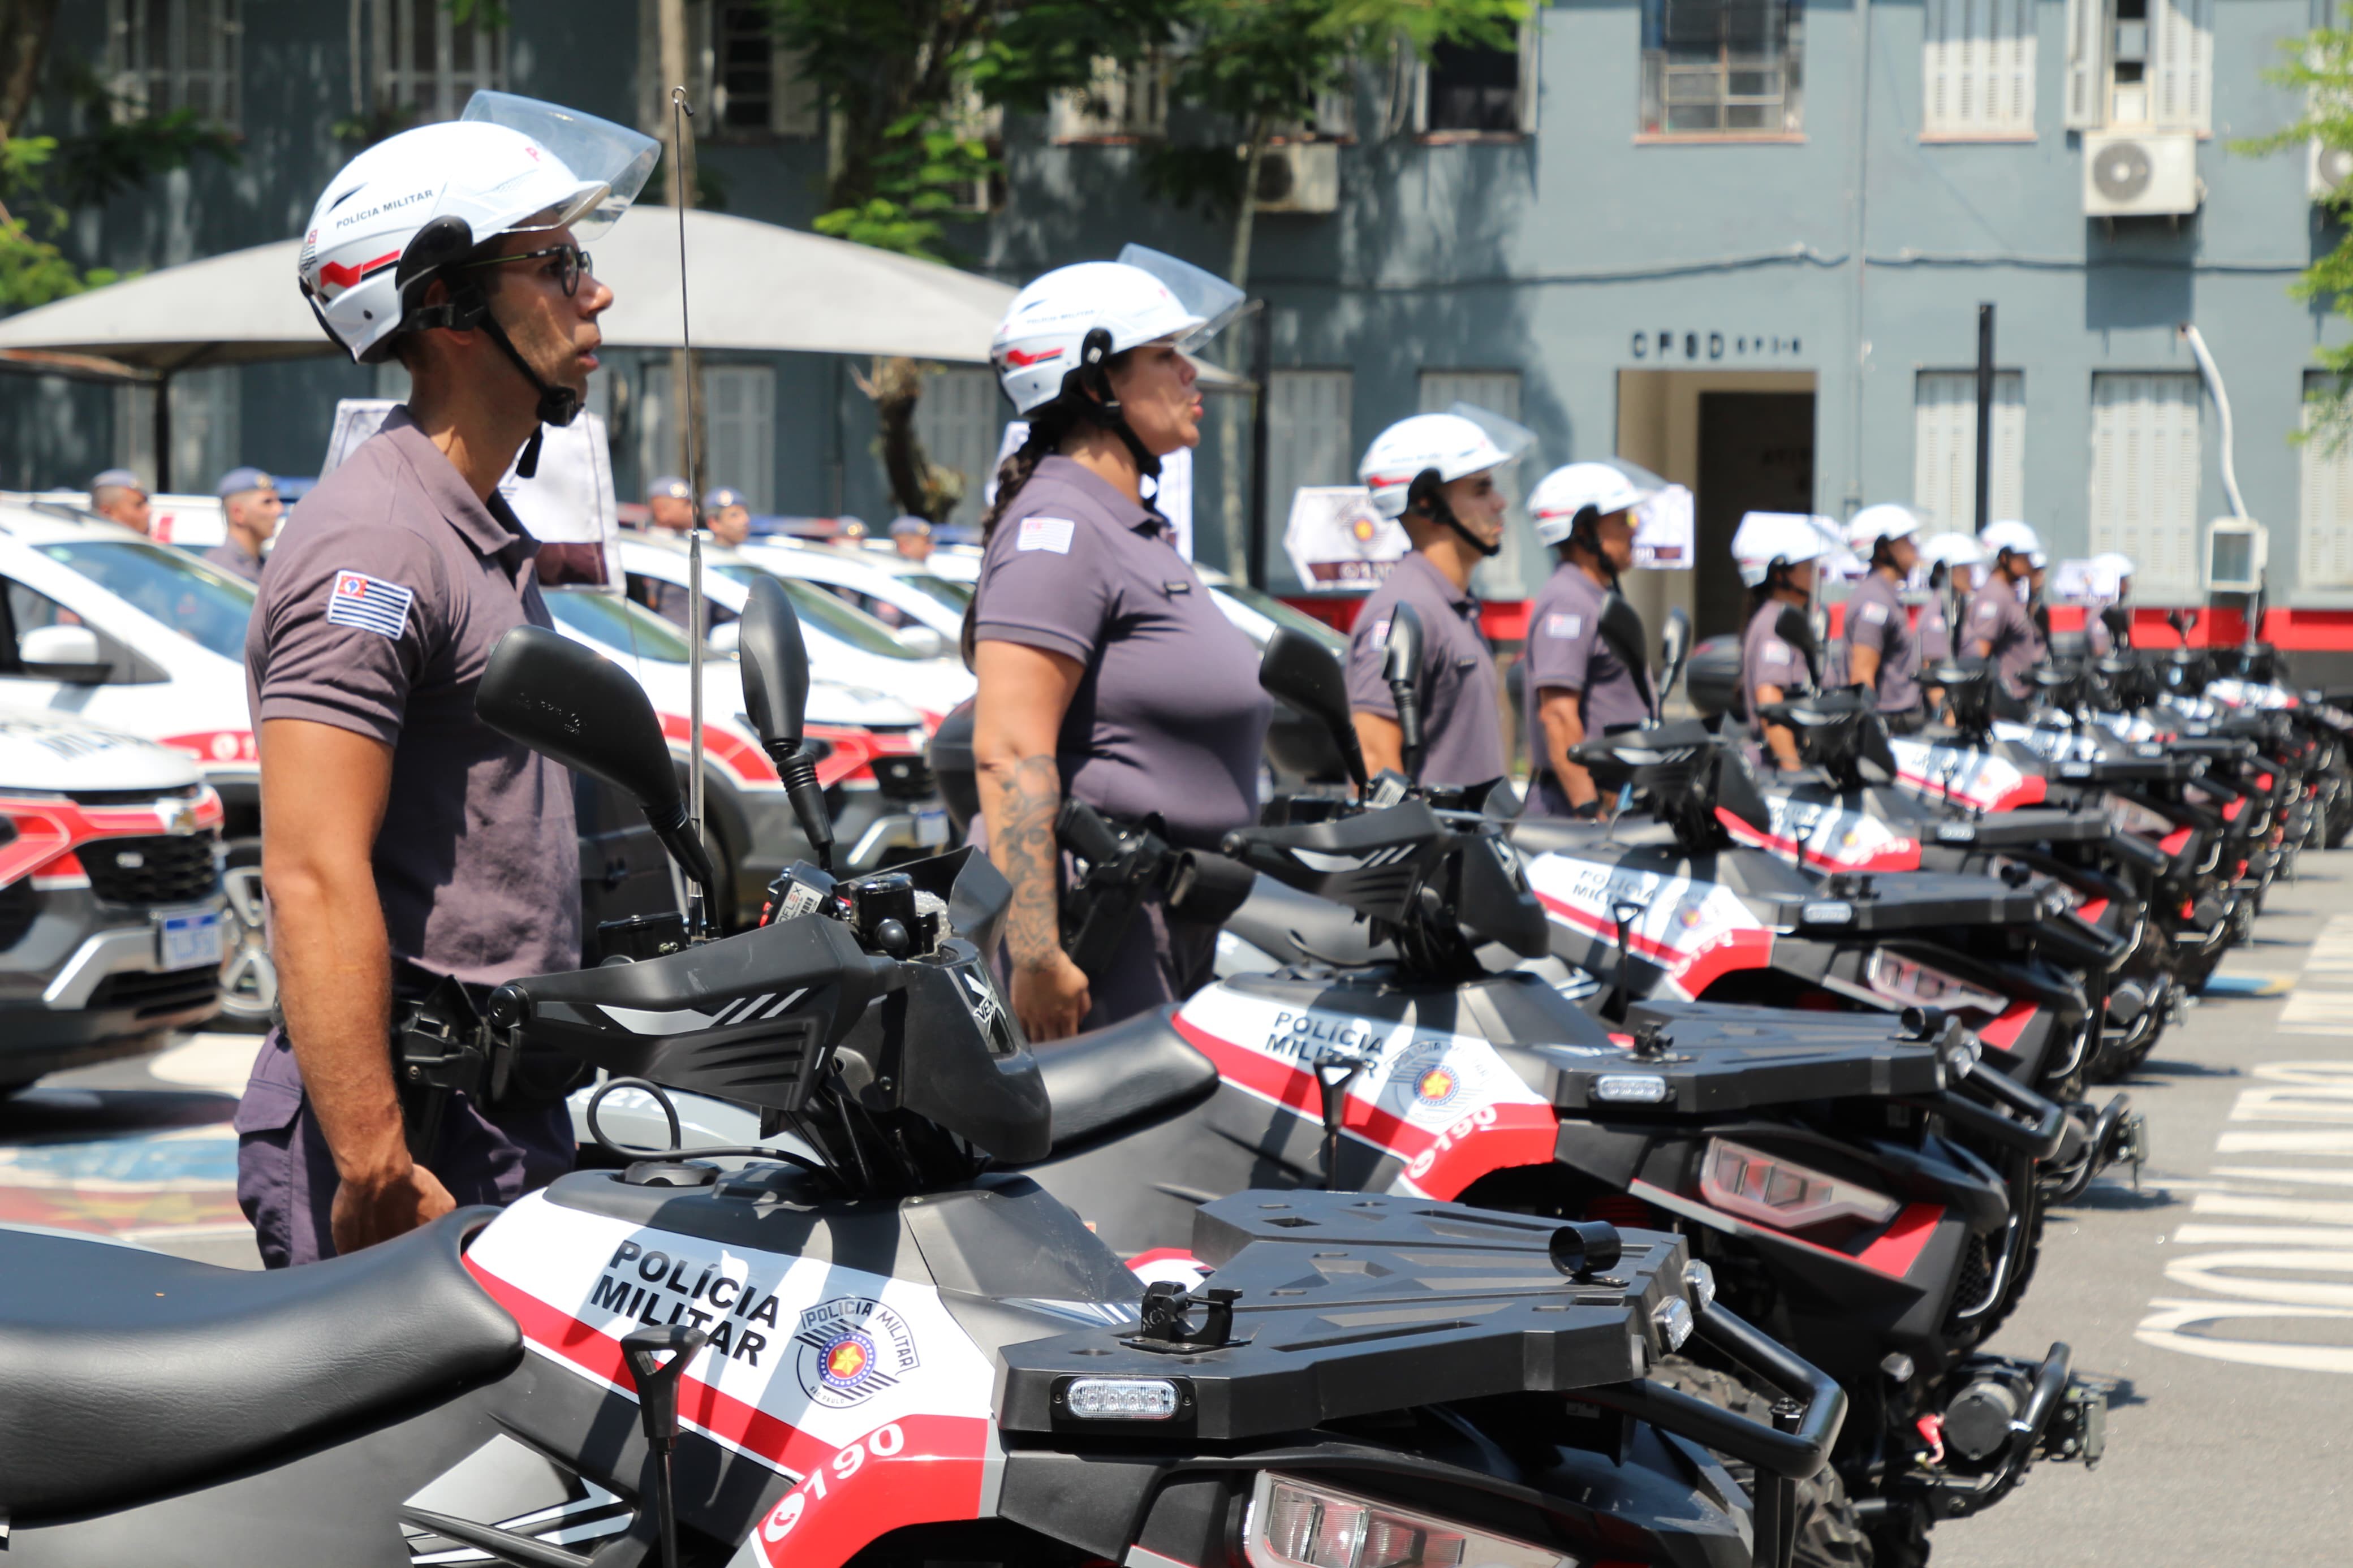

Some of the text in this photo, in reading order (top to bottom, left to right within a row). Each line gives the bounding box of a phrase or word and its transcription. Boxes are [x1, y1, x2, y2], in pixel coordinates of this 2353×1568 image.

[383, 189, 433, 212] MILITAR
[1265, 1033, 1378, 1078] MILIR
[1274, 1011, 1384, 1055] POLÍCIA
[1434, 1106, 1498, 1152] 190
[609, 1239, 779, 1330] POLÍCIA
[805, 1301, 914, 1368] POLICIA MILITAR
[822, 1395, 845, 1404] PAULO
[805, 1423, 904, 1501] 190
